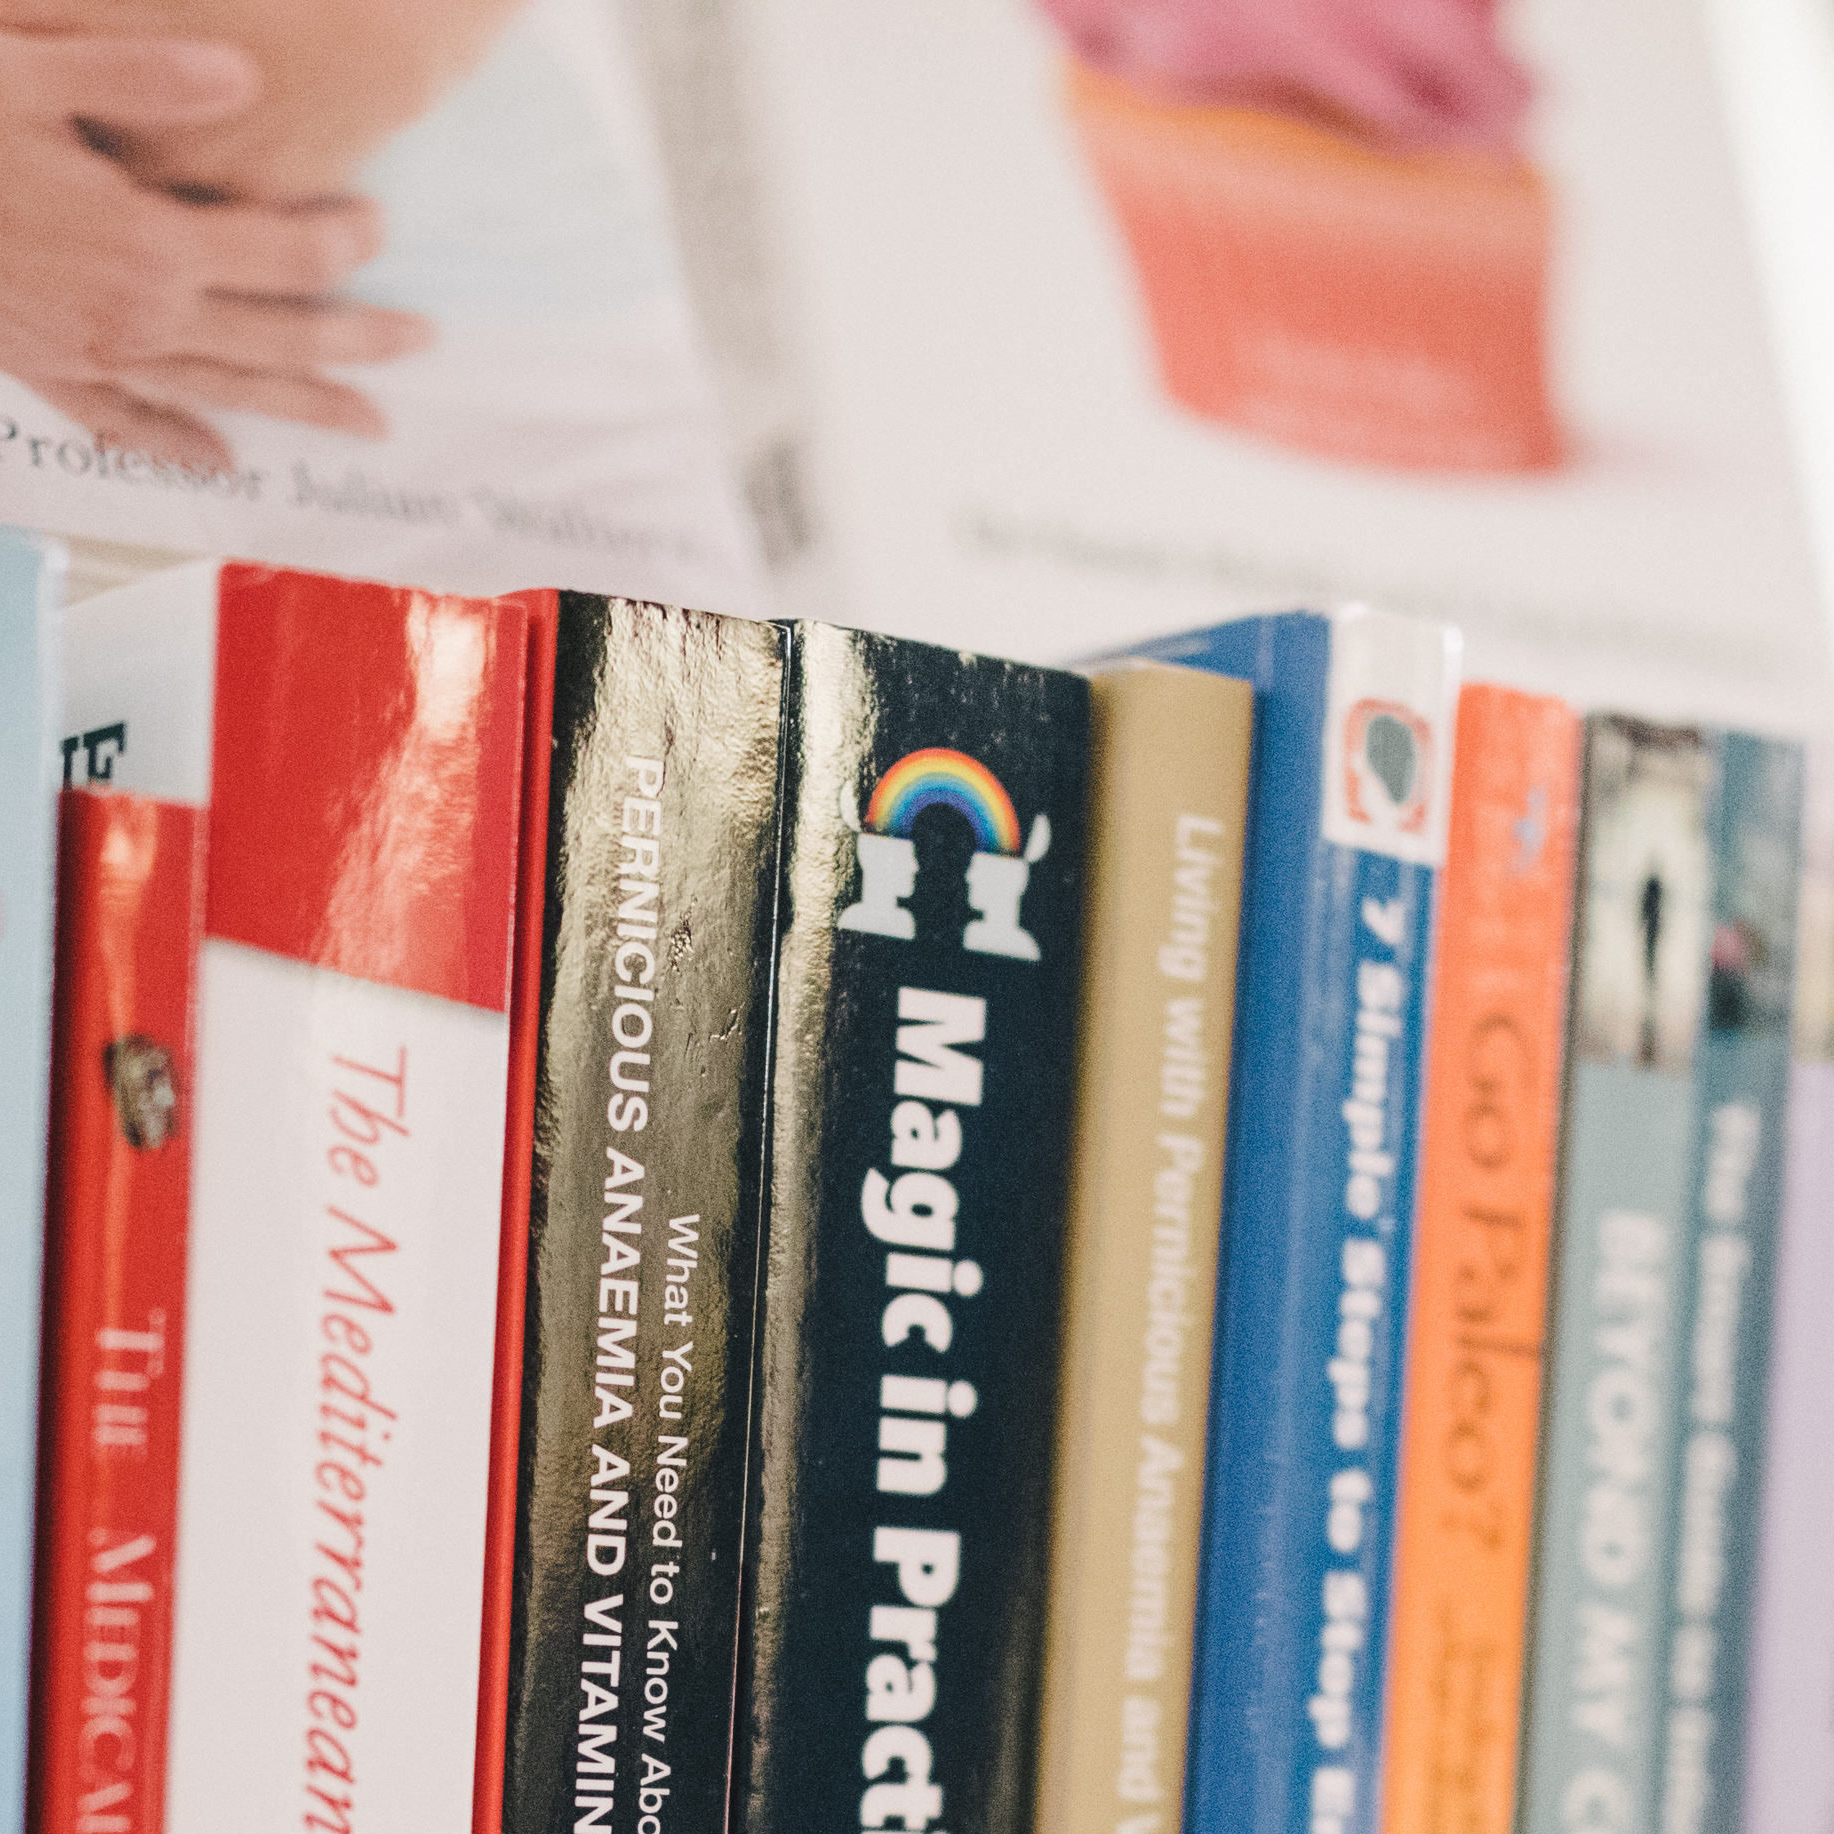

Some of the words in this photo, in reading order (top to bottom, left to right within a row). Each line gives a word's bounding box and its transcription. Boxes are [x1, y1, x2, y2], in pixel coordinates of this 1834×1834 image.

[606, 755, 665, 1134] PERNICIOUS
[1158, 812, 1224, 982] Living
[1362, 903, 1407, 946] 7
[325, 1045, 412, 1188] The
[1159, 999, 1211, 1117] with
[1341, 962, 1405, 1221] Simple
[1464, 1010, 1540, 1174] Go
[860, 984, 988, 1353] Magic
[593, 1148, 646, 1430] ANAEMIA
[663, 1213, 701, 1326] What
[1140, 1133, 1207, 1426] Pernicious
[657, 1340, 695, 1421] You
[1325, 1238, 1387, 1448] Steps
[1441, 1205, 1543, 1554] Paleo?
[1579, 1208, 1667, 1591] BEYOND
[651, 1433, 689, 1548] Need
[874, 1374, 979, 1496] in
[586, 1443, 631, 1577] AND
[1124, 1435, 1185, 1682] Anaemia
[1328, 1468, 1377, 1555] to
[648, 1562, 682, 1605] to
[642, 1618, 680, 1744] Know
[1307, 1570, 1370, 1748] Stop
[1568, 1602, 1637, 1748] MY
[1118, 1694, 1165, 1802] and
